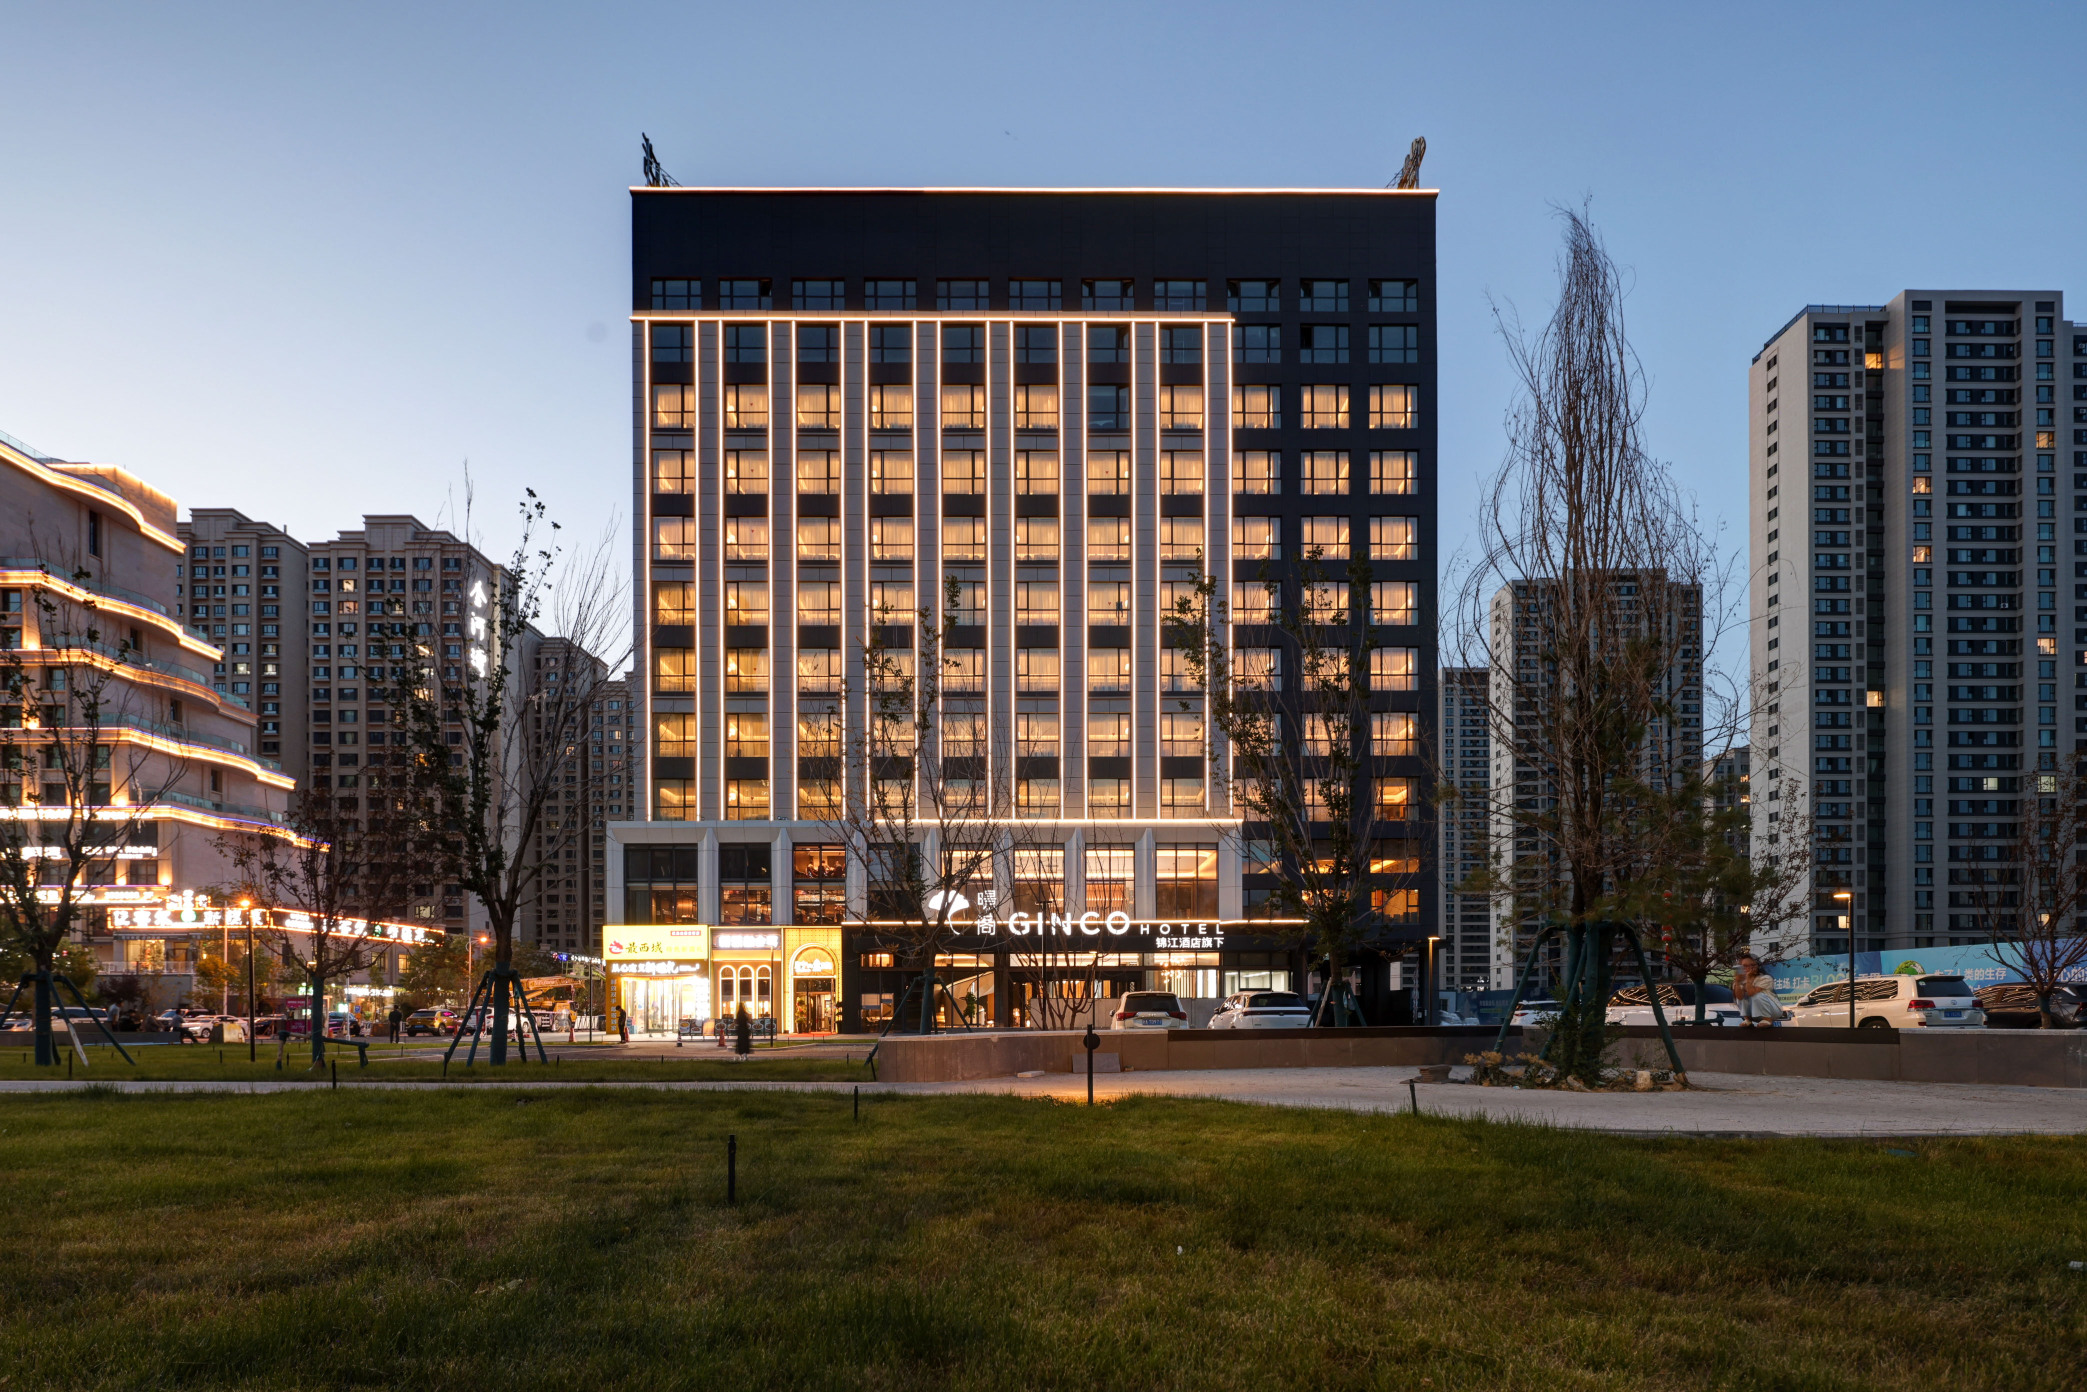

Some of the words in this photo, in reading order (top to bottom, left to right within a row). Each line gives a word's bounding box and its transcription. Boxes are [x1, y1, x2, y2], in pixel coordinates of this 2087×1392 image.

[1008, 910, 1131, 936] GINCO
[1140, 923, 1224, 935] HOTEL
[1155, 936, 1225, 949] 锦江酒店旗下
